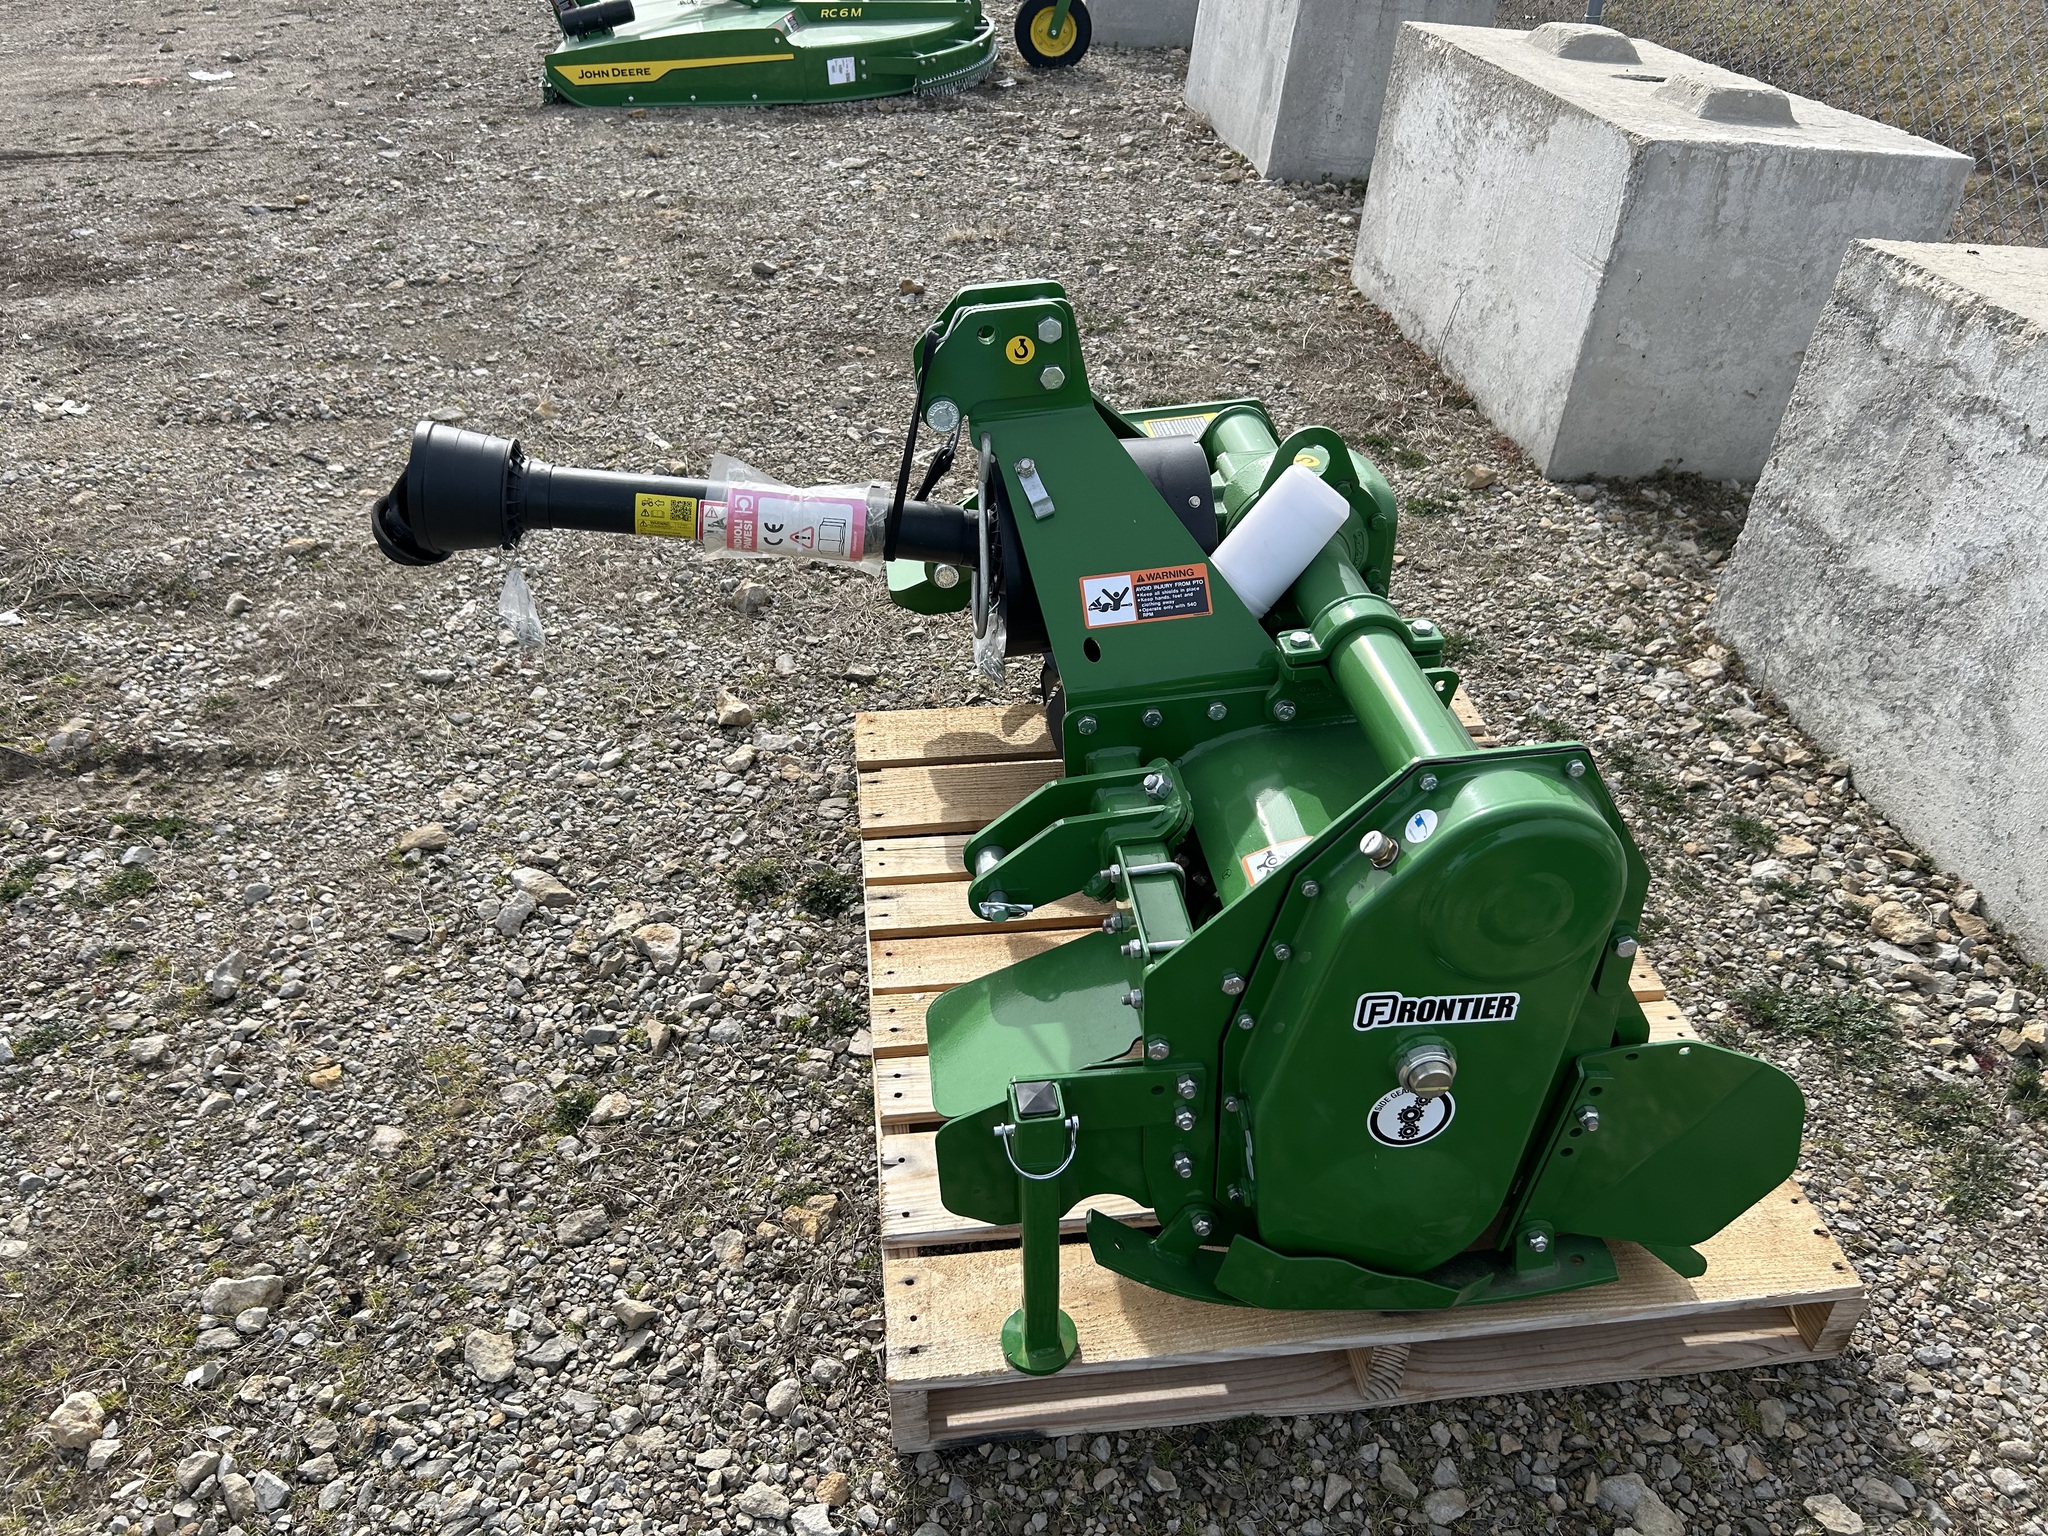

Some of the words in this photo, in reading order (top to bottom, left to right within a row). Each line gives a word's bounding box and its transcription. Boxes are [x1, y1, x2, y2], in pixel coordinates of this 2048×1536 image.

[821, 9, 837, 18] RC
[840, 8, 848, 17] 6
[851, 8, 862, 17] M
[578, 69, 609, 79] JOHN
[611, 67, 651, 77] DEERE
[1146, 568, 1194, 581] WARNING
[1356, 994, 1517, 1029] FRONTIER
[1374, 1096, 1392, 1112] SIDE
